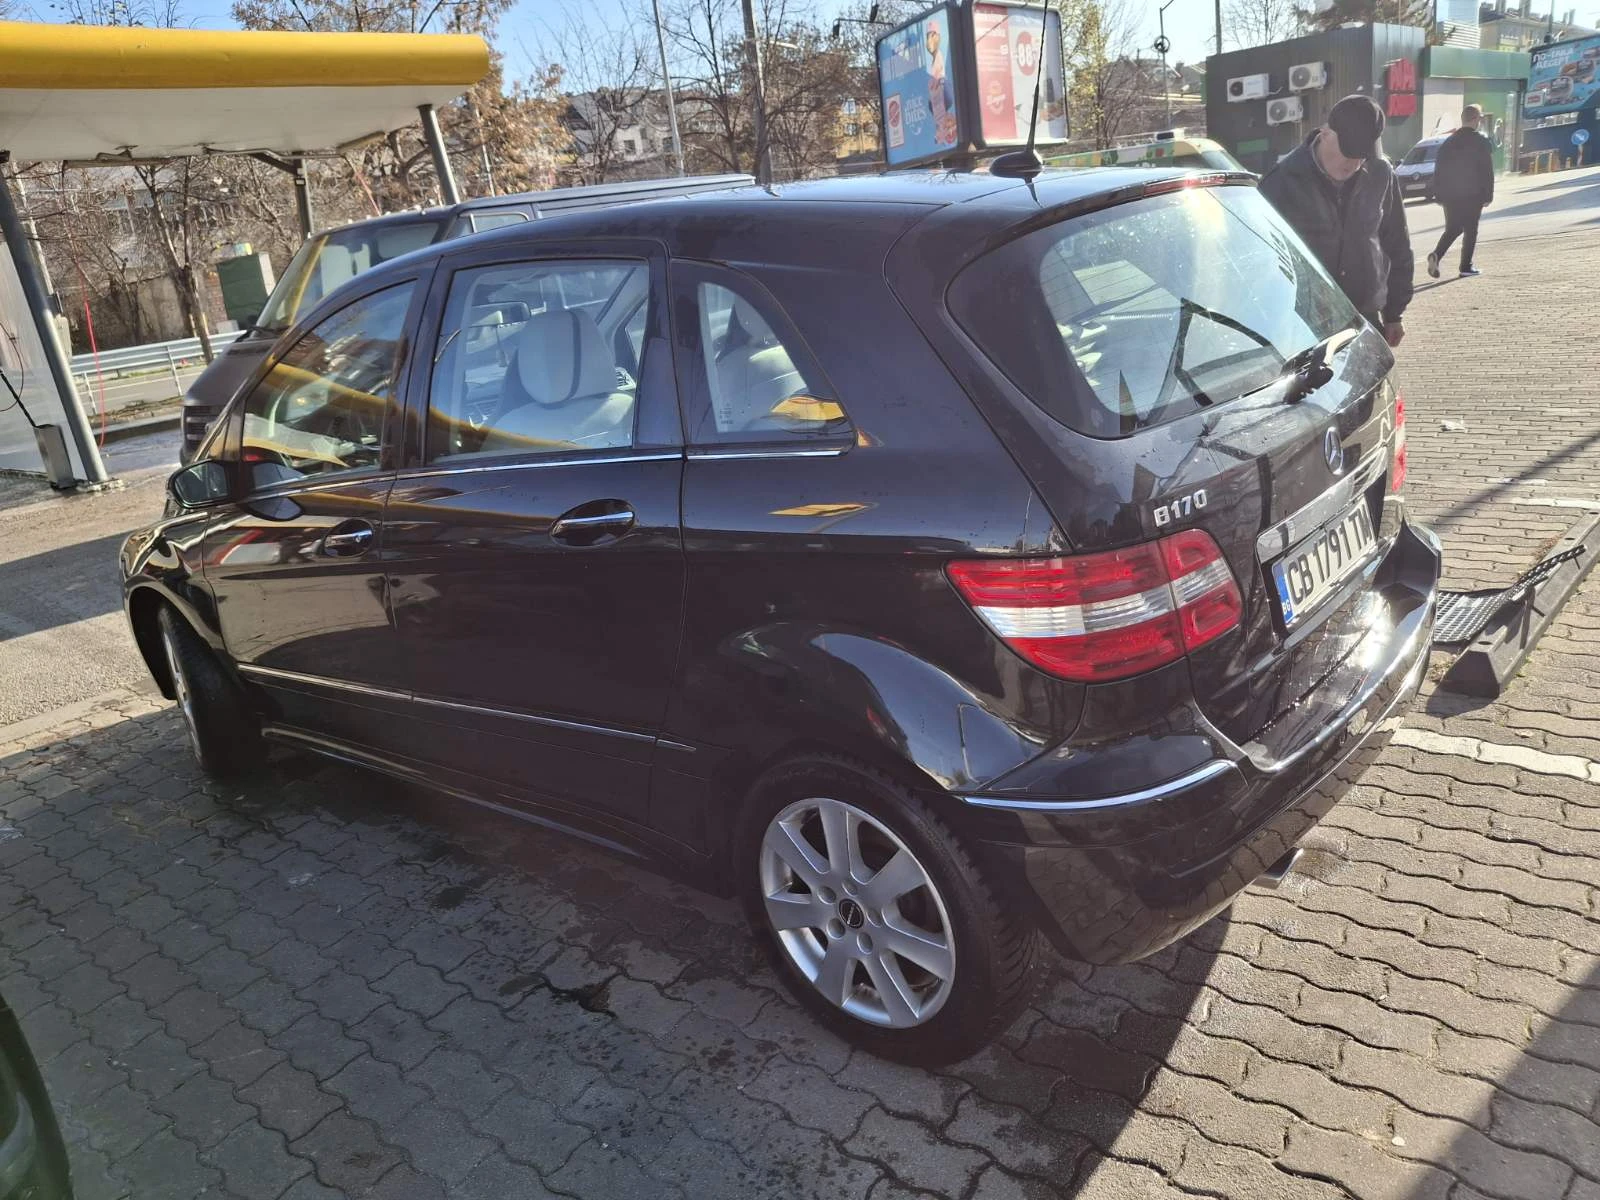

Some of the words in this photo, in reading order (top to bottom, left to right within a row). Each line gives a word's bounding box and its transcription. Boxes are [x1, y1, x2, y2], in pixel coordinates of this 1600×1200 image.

[1153, 489, 1208, 527] B170
[1286, 553, 1314, 604] CB
[1313, 520, 1352, 583] 1791
